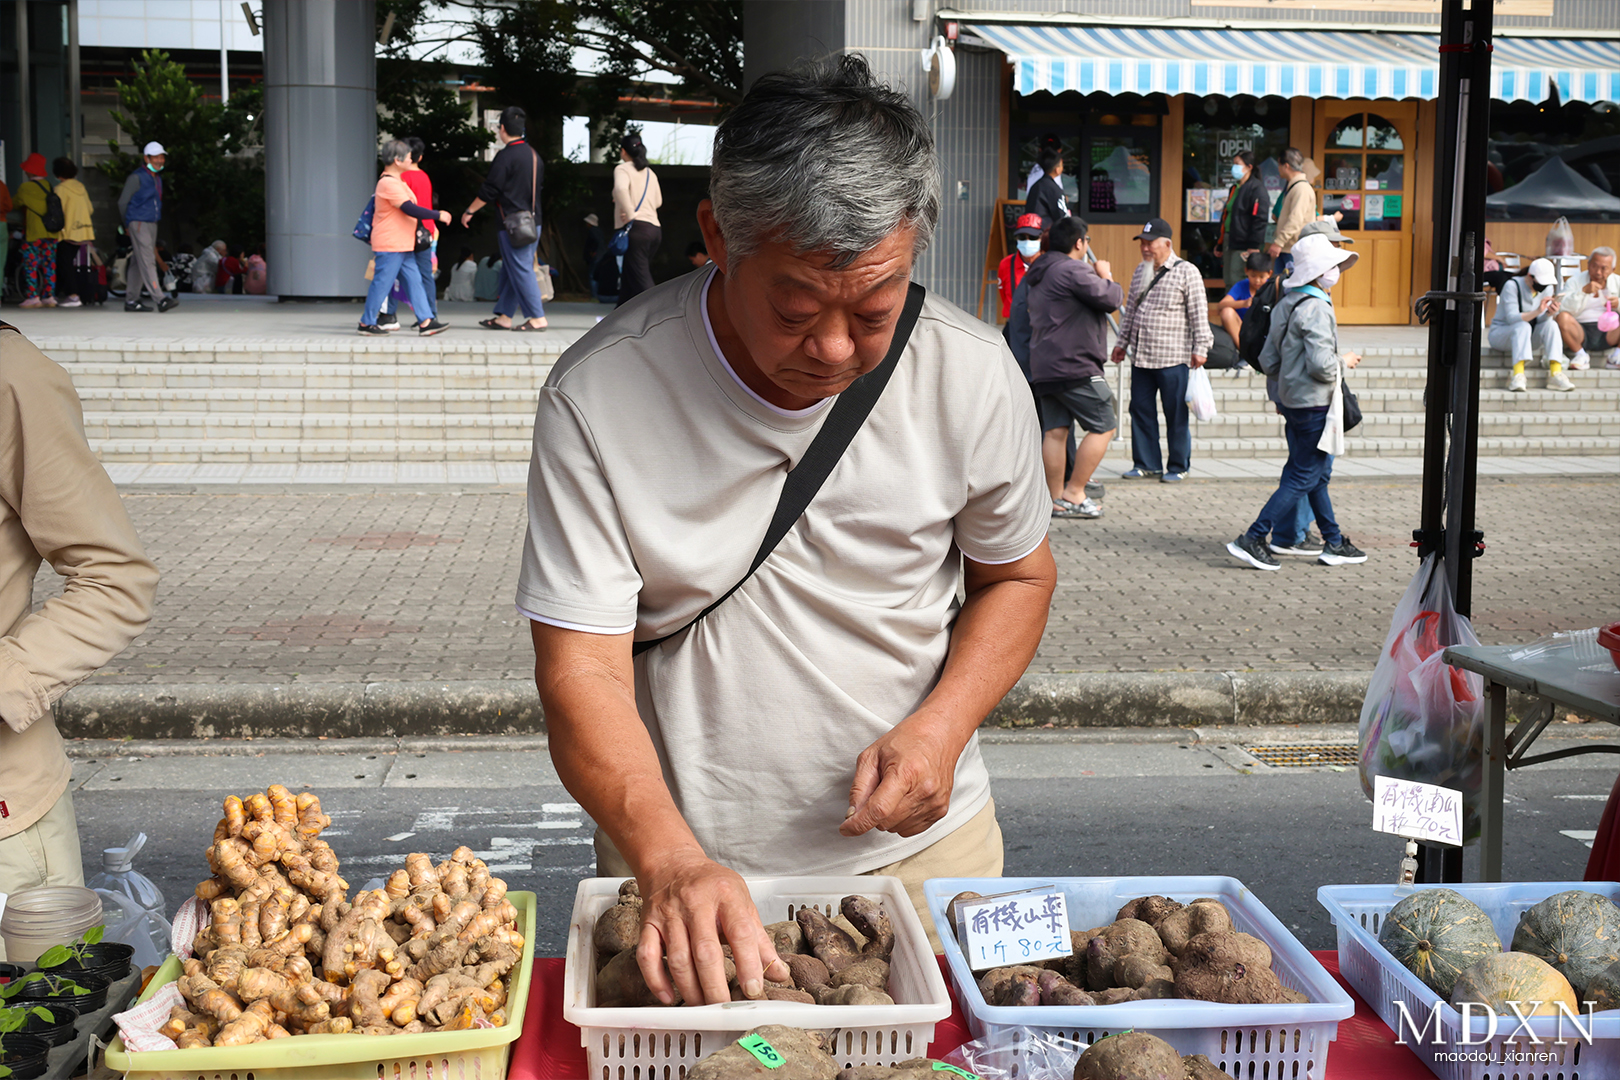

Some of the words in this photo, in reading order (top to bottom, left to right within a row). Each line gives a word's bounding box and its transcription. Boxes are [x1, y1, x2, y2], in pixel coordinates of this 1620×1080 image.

[1219, 139, 1252, 157] OPEN
[981, 940, 1008, 963] 1斤
[1018, 935, 1071, 957] 80元
[752, 1042, 779, 1061] 150
